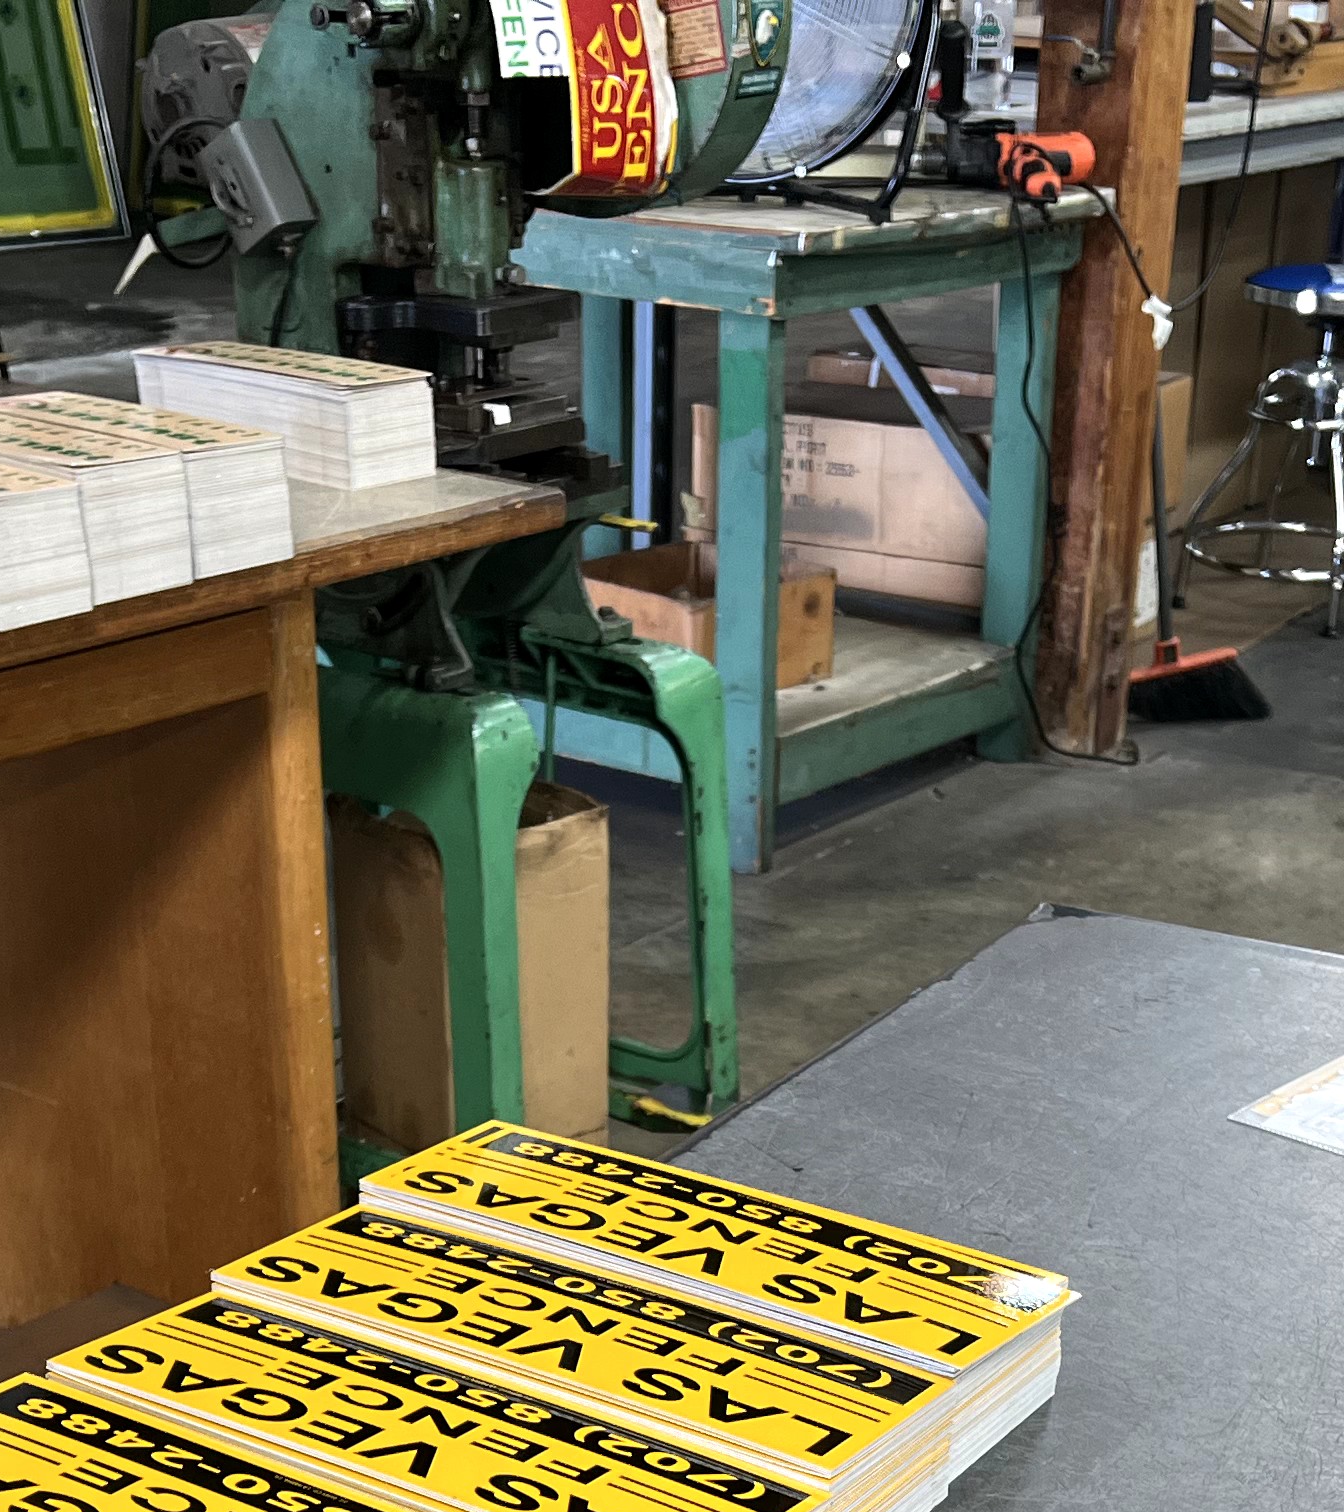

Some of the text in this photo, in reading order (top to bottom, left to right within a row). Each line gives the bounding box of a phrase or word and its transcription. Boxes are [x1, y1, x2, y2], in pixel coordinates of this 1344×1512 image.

[587, 23, 624, 164] USA
[612, 2, 652, 185] ENC
[515, 1139, 821, 1232] 850-2488
[565, 1182, 879, 1282] FENCE
[364, 1219, 892, 1383] (702) 850-2488
[407, 1164, 982, 1355] LAS VEGAS
[416, 1266, 745, 1375] FENCE
[85, 1340, 437, 1478] VEGAS
[216, 1309, 765, 1495] (702) 850-2488
[250, 1249, 855, 1452] LAS VEGAS
[265, 1362, 610, 1484] FENCE
